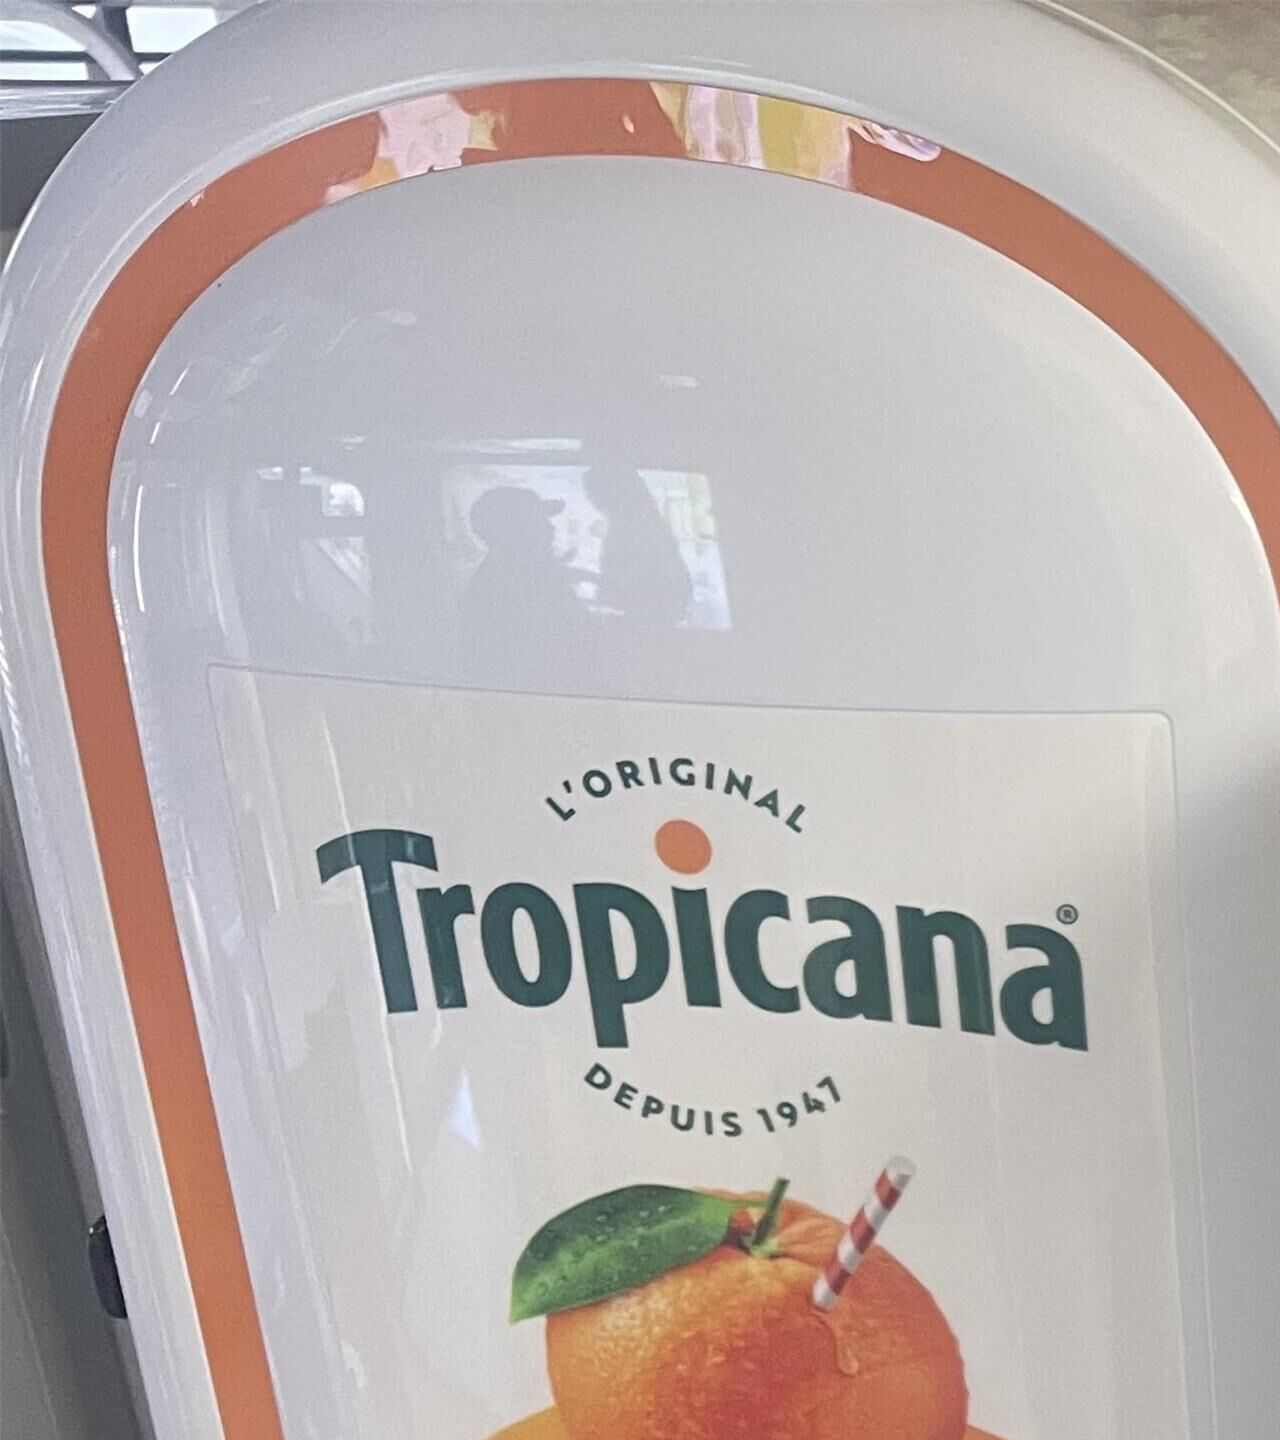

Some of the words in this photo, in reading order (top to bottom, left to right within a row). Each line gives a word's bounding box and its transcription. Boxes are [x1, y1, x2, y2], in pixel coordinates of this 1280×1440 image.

[544, 756, 807, 834] L'ORIGINAL
[583, 1061, 743, 1138] DEPUIS
[756, 1075, 842, 1133] 1947
